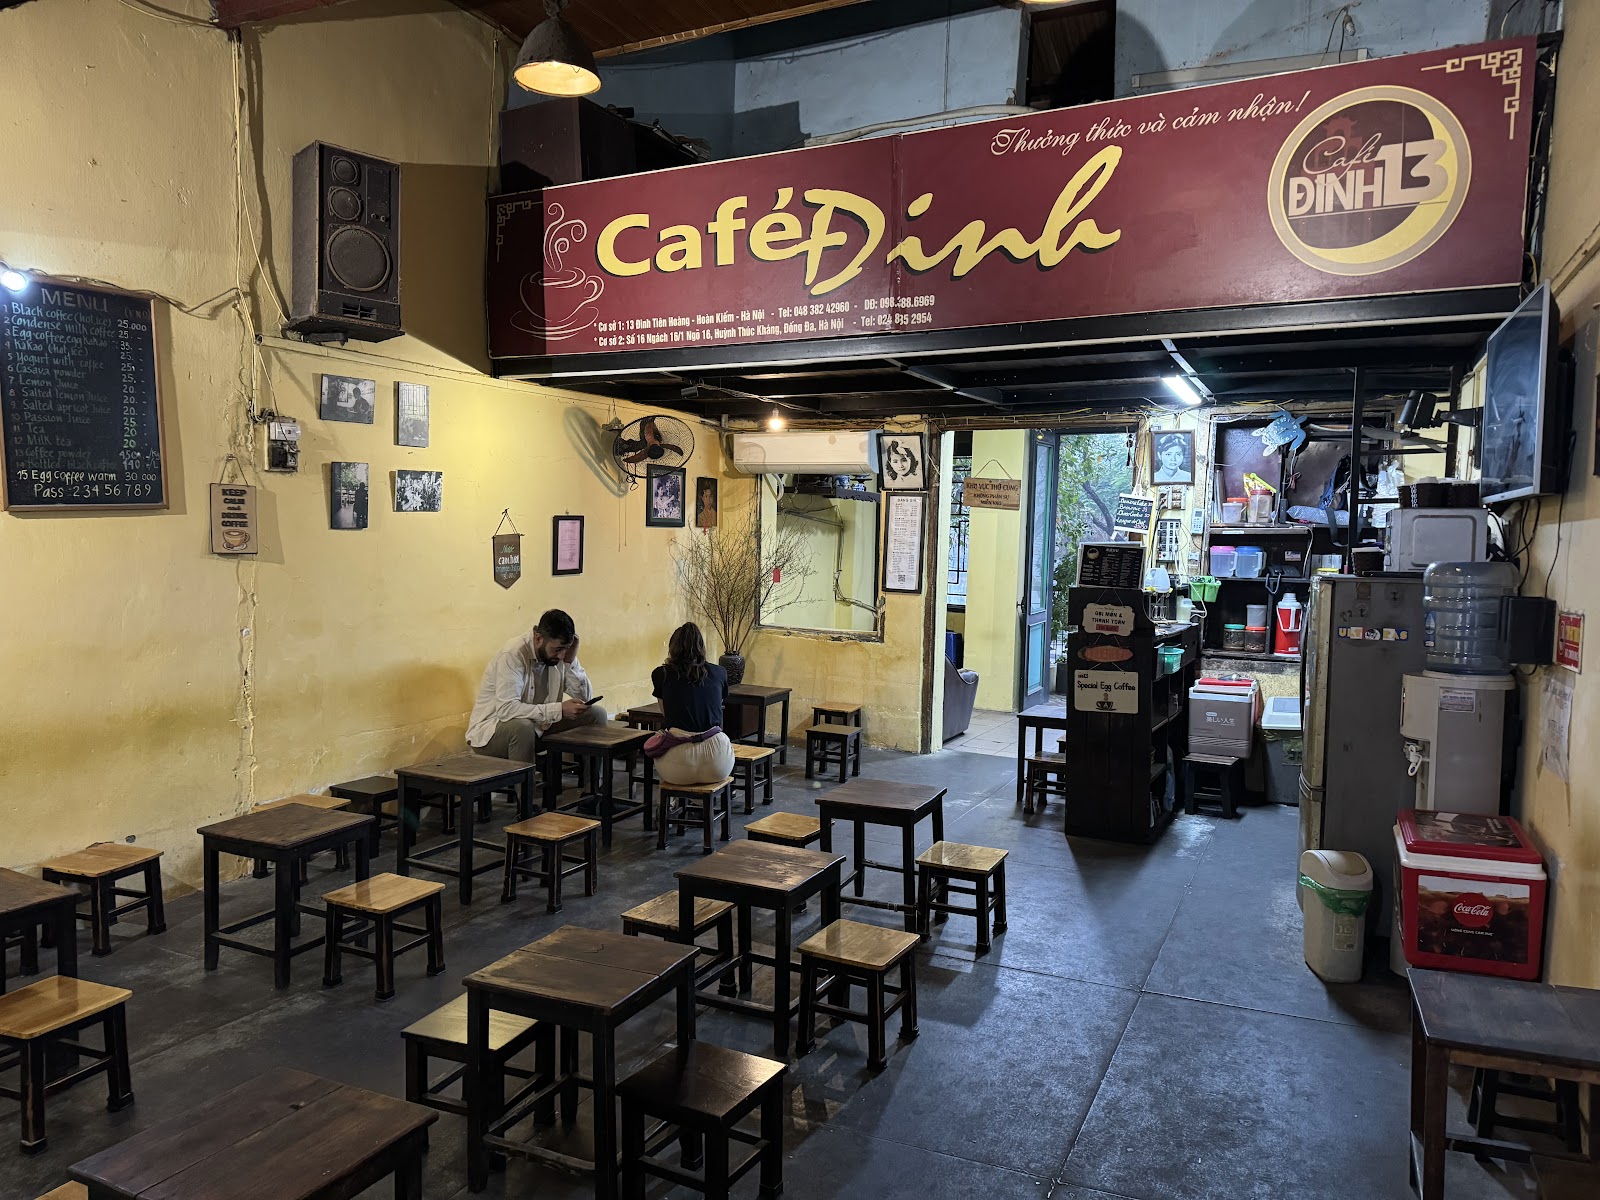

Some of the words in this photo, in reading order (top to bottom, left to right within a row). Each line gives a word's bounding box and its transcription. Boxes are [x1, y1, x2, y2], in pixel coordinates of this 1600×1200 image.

[991, 127, 1080, 156] Thưởng
[1086, 117, 1132, 141] thức
[1137, 112, 1166, 134] và
[1173, 107, 1221, 130] cảm
[1228, 90, 1311, 122] nhận!
[1374, 139, 1449, 206] 13
[596, 187, 802, 277] Café
[798, 144, 1122, 296] Đinh
[41, 288, 107, 312] MENU
[12, 302, 43, 317] Black
[46, 309, 73, 321] coffee
[118, 320, 146, 331] 25.000
[599, 322, 607, 331] Cơ
[618, 321, 624, 330] 1:
[626, 320, 634, 330] 13
[652, 318, 667, 328] Tiên
[668, 316, 690, 327] Hoàng
[697, 314, 714, 324] Hoàn
[716, 311, 734, 323] Kiếm
[741, 310, 750, 321] Hà
[752, 309, 764, 322] Nội
[778, 307, 792, 318] Tel:
[794, 305, 808, 316] 048
[810, 304, 824, 315] 382
[826, 302, 849, 313] 42960
[12, 316, 60, 330] Condense
[90, 326, 114, 339] coffee
[599, 337, 607, 346] Cơ
[618, 336, 625, 345] 2:
[626, 333, 635, 345] Số
[637, 334, 645, 344] 16
[647, 332, 668, 344] Ngách
[670, 331, 683, 341] 16/1
[686, 329, 700, 341] Ngõ
[702, 330, 712, 340] 16,
[715, 328, 736, 339] Huỳnh
[738, 326, 754, 336] Thúc
[757, 324, 781, 335] Kháng,
[784, 321, 802, 334] Đống
[805, 321, 816, 332] Đa,
[819, 320, 828, 331] Hà
[831, 318, 843, 331] Nội
[861, 315, 875, 326] Tel:
[878, 314, 892, 325] 024
[911, 312, 932, 324] 2954
[16, 352, 49, 366] Yogurt
[53, 356, 74, 366] with
[80, 360, 104, 373] coffee
[20, 375, 52, 387] Lemon
[53, 369, 87, 380] powder
[22, 387, 52, 399] Salted
[23, 399, 53, 411] Salted
[57, 404, 89, 415] apricot
[25, 412, 63, 423] Passion
[26, 423, 44, 433] Tea
[56, 438, 71, 447] tea
[26, 447, 54, 459] Coffee
[17, 470, 28, 480] 15
[32, 470, 52, 483] Egg
[54, 471, 84, 485] coffee
[88, 472, 117, 481] warm
[125, 472, 137, 481] 30
[142, 473, 156, 481] 000
[34, 484, 64, 498] Pass
[1077, 680, 1098, 690] Special
[1100, 681, 1111, 692] Egg
[1114, 682, 1135, 690] Coffee
